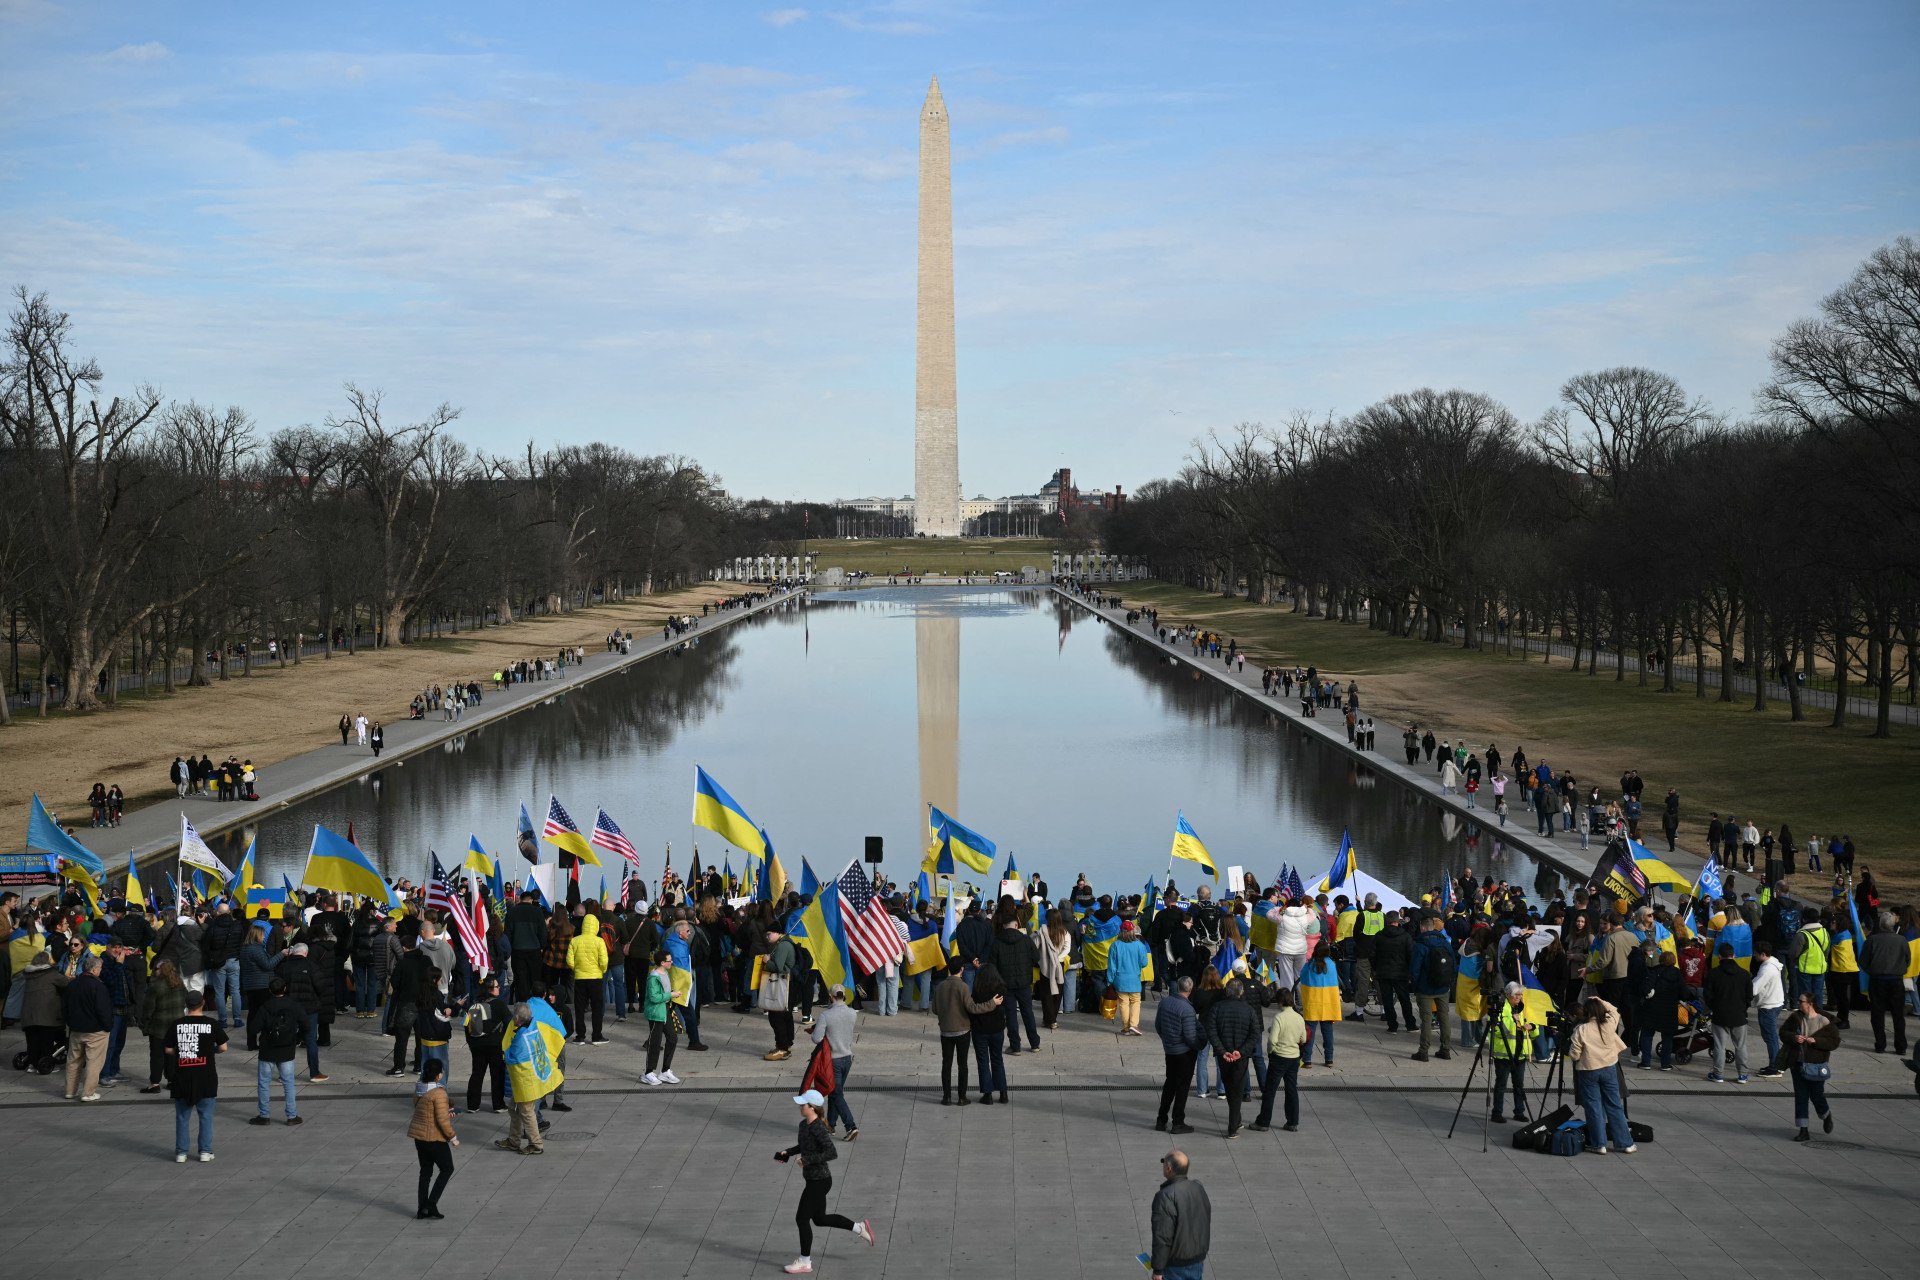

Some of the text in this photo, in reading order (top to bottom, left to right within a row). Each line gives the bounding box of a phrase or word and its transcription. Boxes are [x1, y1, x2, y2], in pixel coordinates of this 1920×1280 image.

[1603, 876, 1636, 904] UKRAINE
[176, 1023, 212, 1033] FIGHTING
[176, 1033, 199, 1042] NAZIS
[177, 1042, 199, 1052] SINCE
